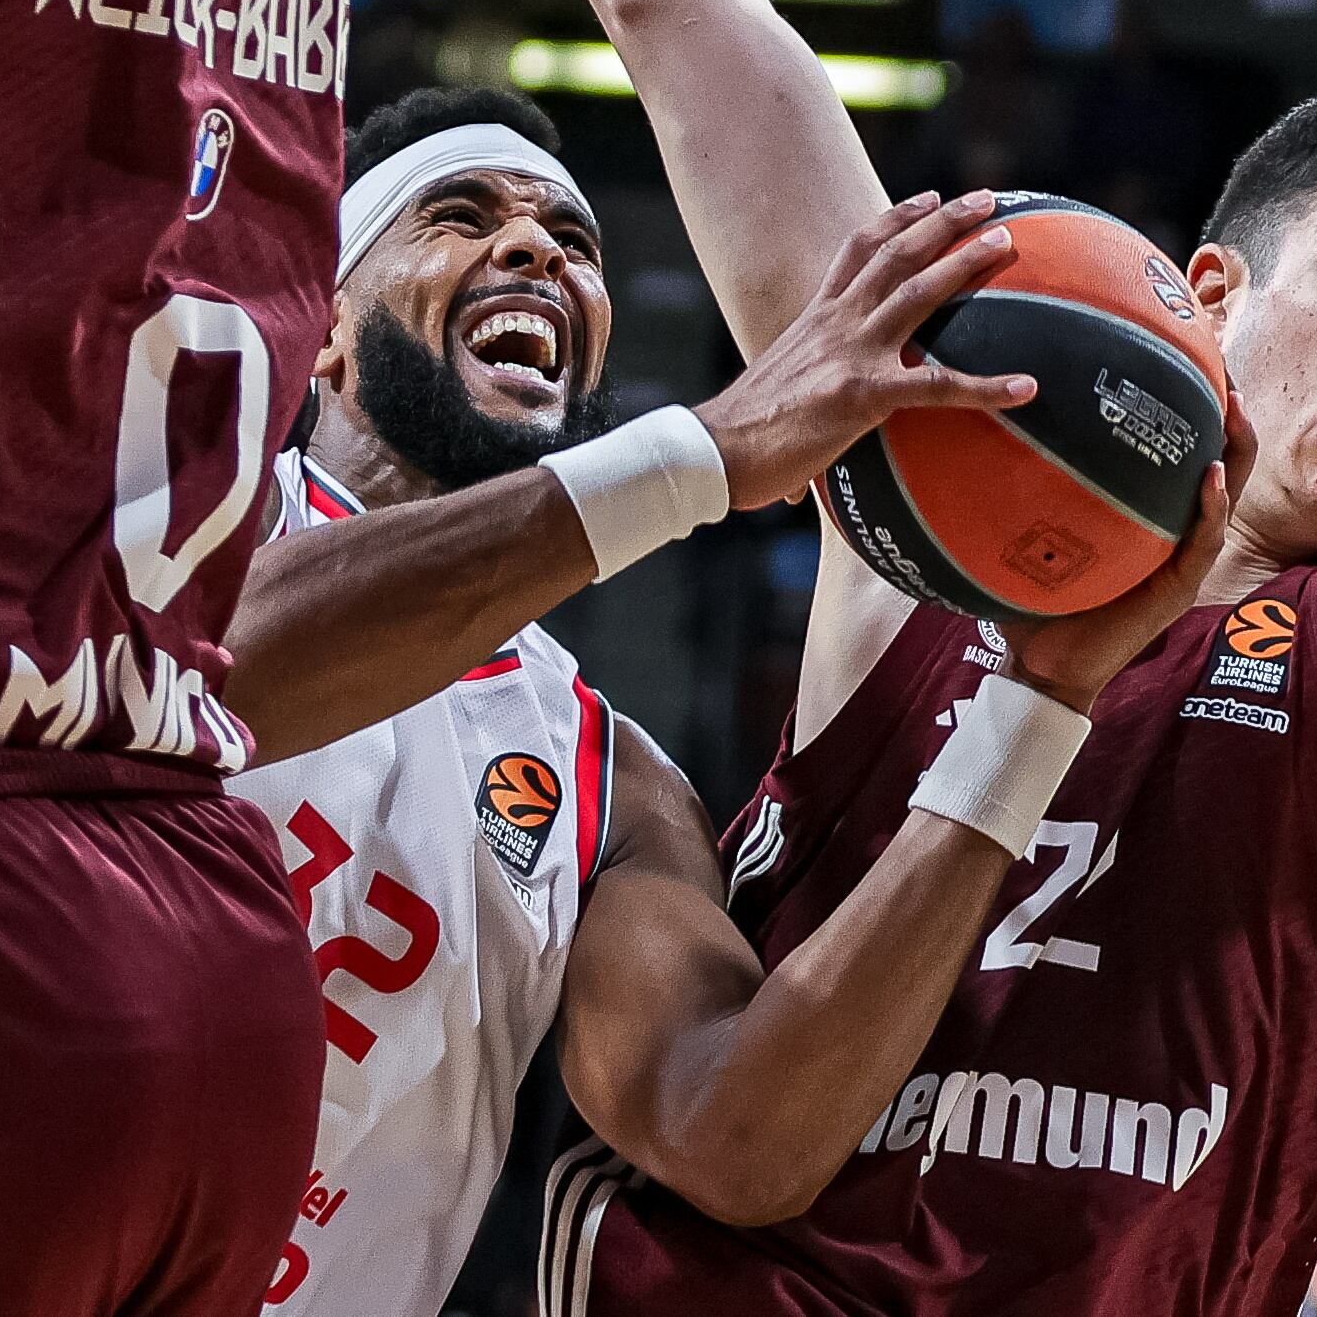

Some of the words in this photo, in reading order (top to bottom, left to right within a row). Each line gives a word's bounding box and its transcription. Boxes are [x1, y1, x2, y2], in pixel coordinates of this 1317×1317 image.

[113, 293, 270, 613] 0
[1214, 666, 1283, 686] AIRLINES
[1218, 655, 1285, 676] TURKISH
[1210, 675, 1279, 693] EuroLeague
[1182, 699, 1287, 732] oneteam
[479, 817, 534, 860] AIRLINES
[481, 806, 539, 850] TURKISH
